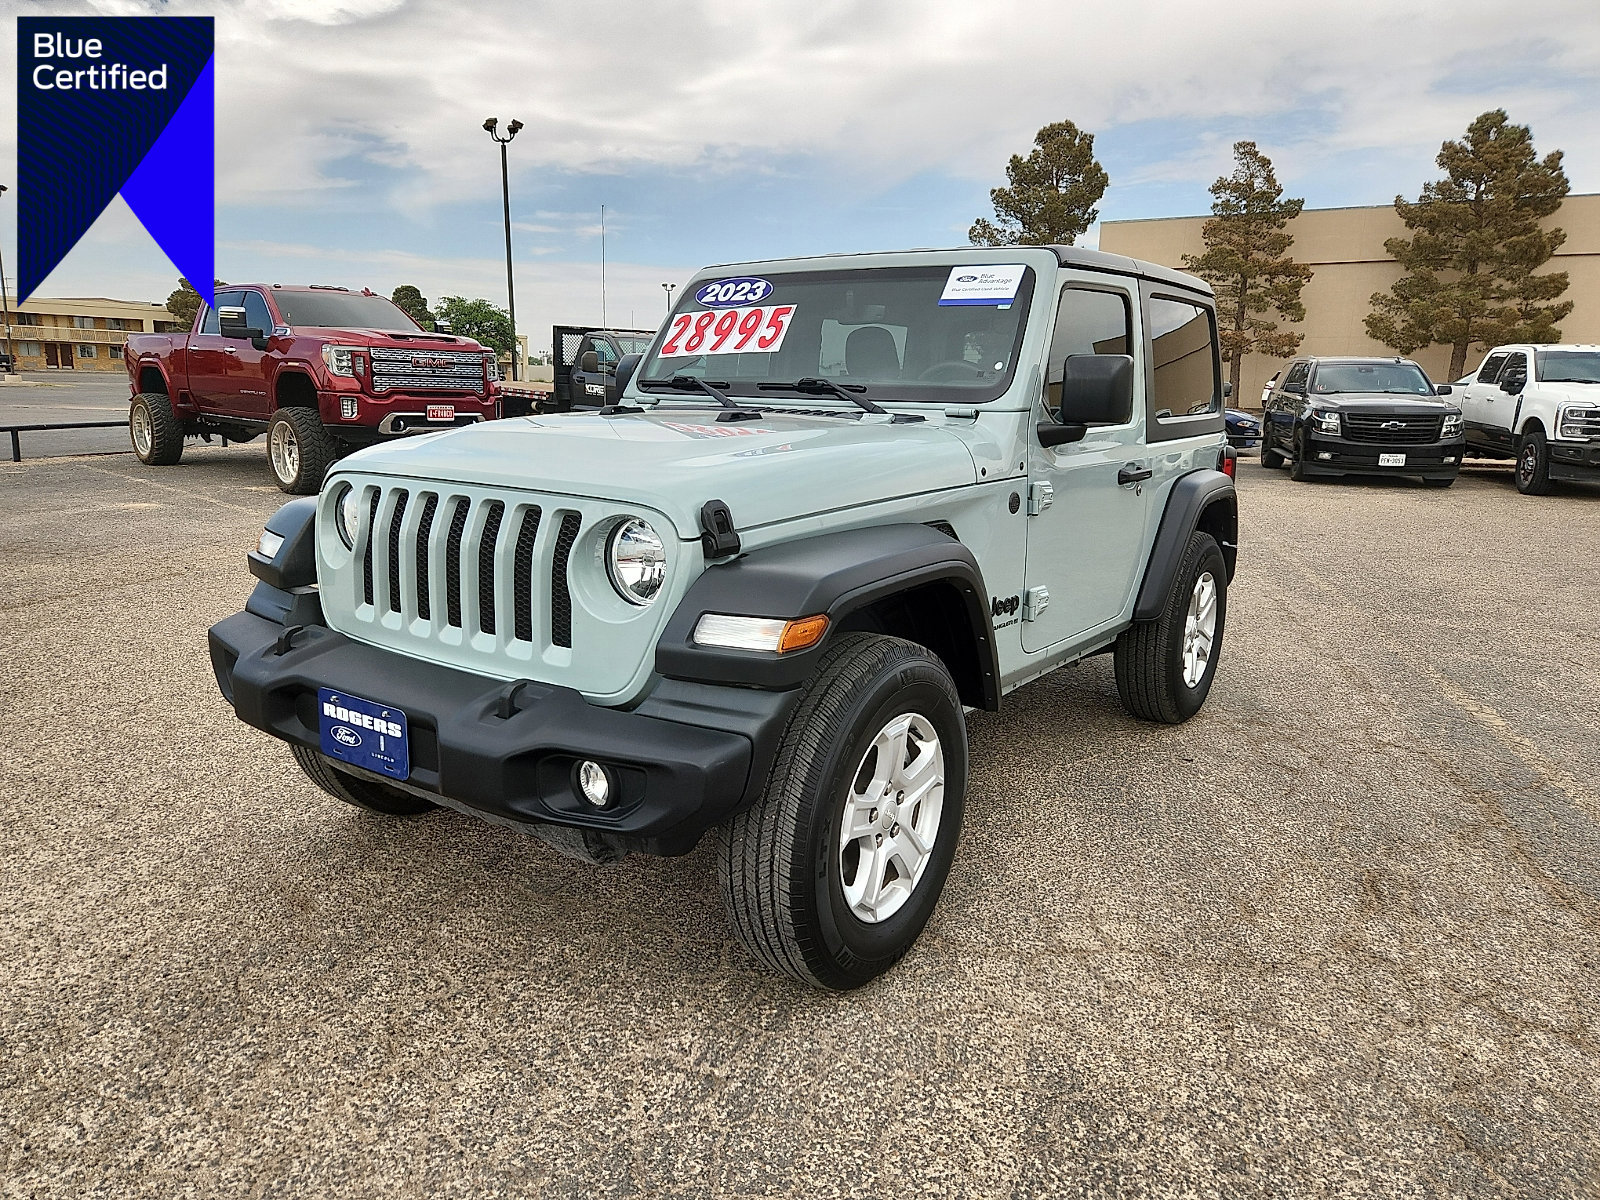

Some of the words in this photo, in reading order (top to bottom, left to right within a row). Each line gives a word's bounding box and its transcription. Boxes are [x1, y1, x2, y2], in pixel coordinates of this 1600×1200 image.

[701, 281, 766, 303] 2023
[661, 307, 793, 354] 28995
[412, 357, 454, 369] GMC
[991, 594, 1020, 617] Jeep
[322, 702, 402, 738] ROGERS
[336, 727, 356, 745] Ford
